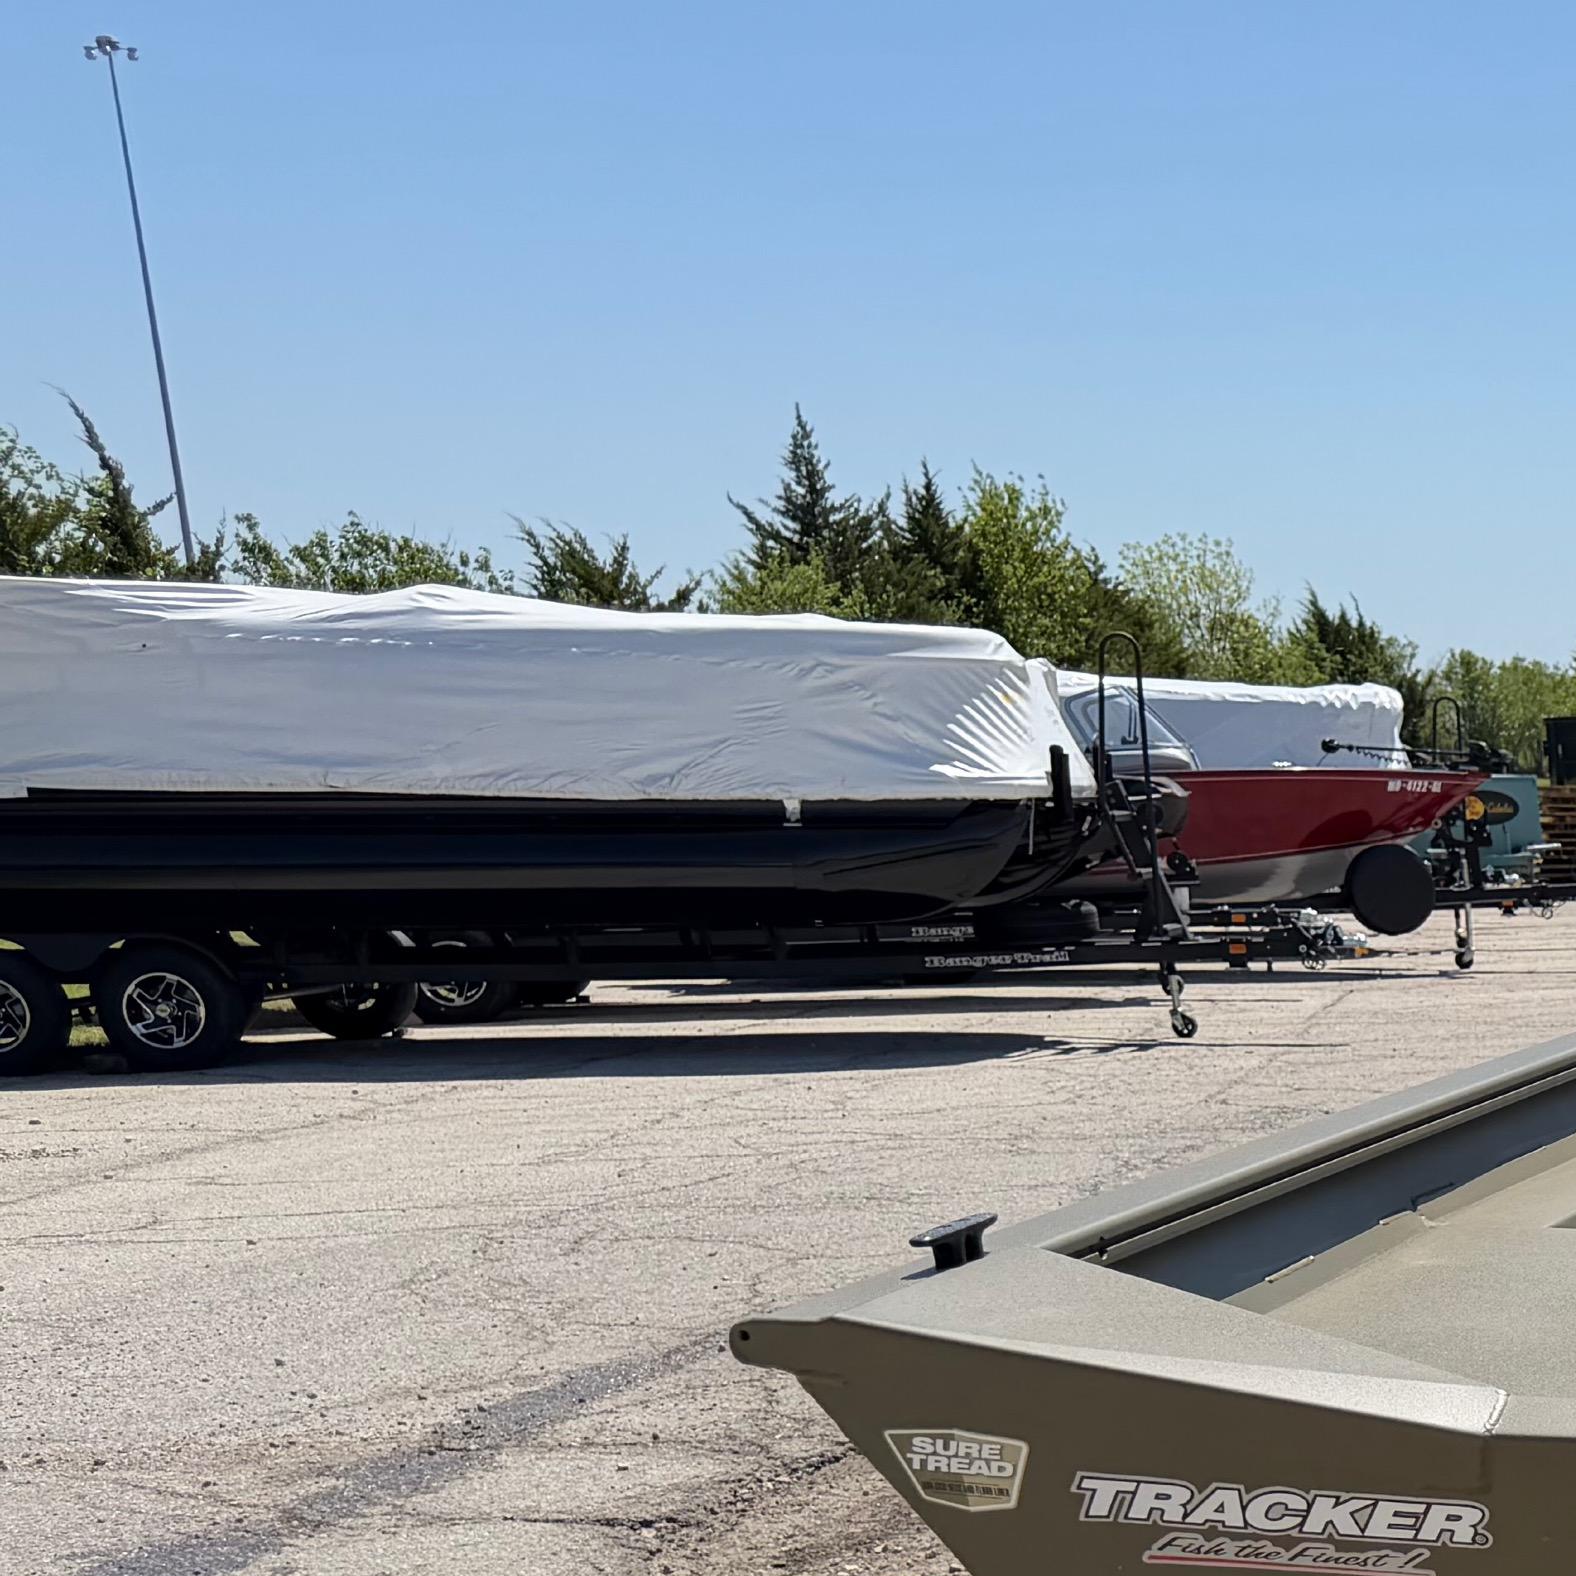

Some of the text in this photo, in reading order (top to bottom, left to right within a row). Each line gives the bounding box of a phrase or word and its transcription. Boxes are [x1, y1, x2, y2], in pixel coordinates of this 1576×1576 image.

[911, 1436, 1002, 1460] SURE
[906, 1453, 1014, 1477] TREAD
[1077, 1475, 1486, 1546] TRACKER
[1157, 1537, 1226, 1556] Fish
[1234, 1543, 1281, 1561] the
